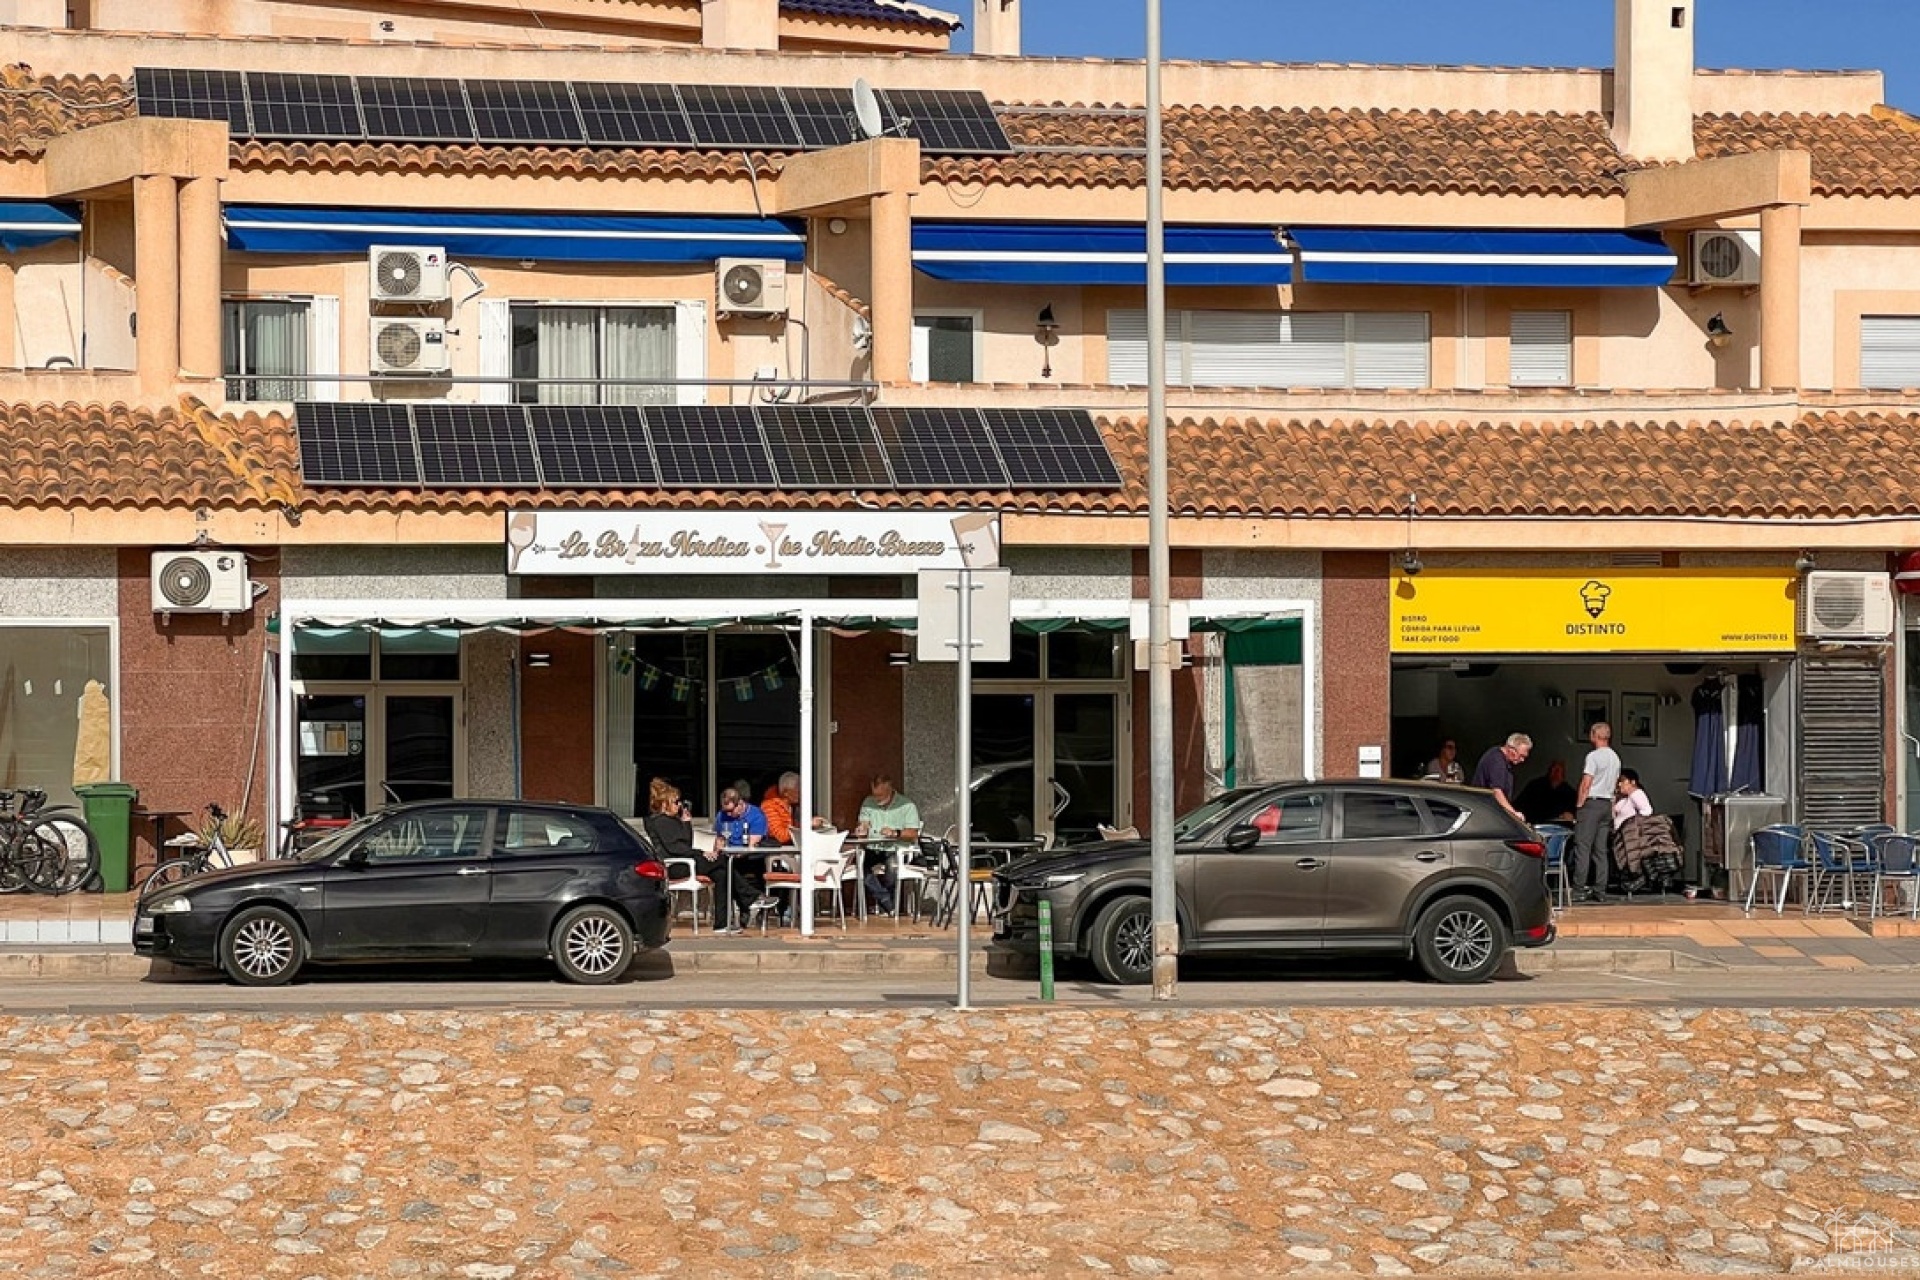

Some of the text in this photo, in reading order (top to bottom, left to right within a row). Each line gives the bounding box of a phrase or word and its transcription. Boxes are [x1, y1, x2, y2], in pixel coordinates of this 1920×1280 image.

[558, 530, 590, 559] La
[594, 526, 664, 563] Brza
[807, 530, 875, 557] Nordic
[876, 530, 945, 557] Breeze
[1566, 623, 1625, 635] DISTINTO
